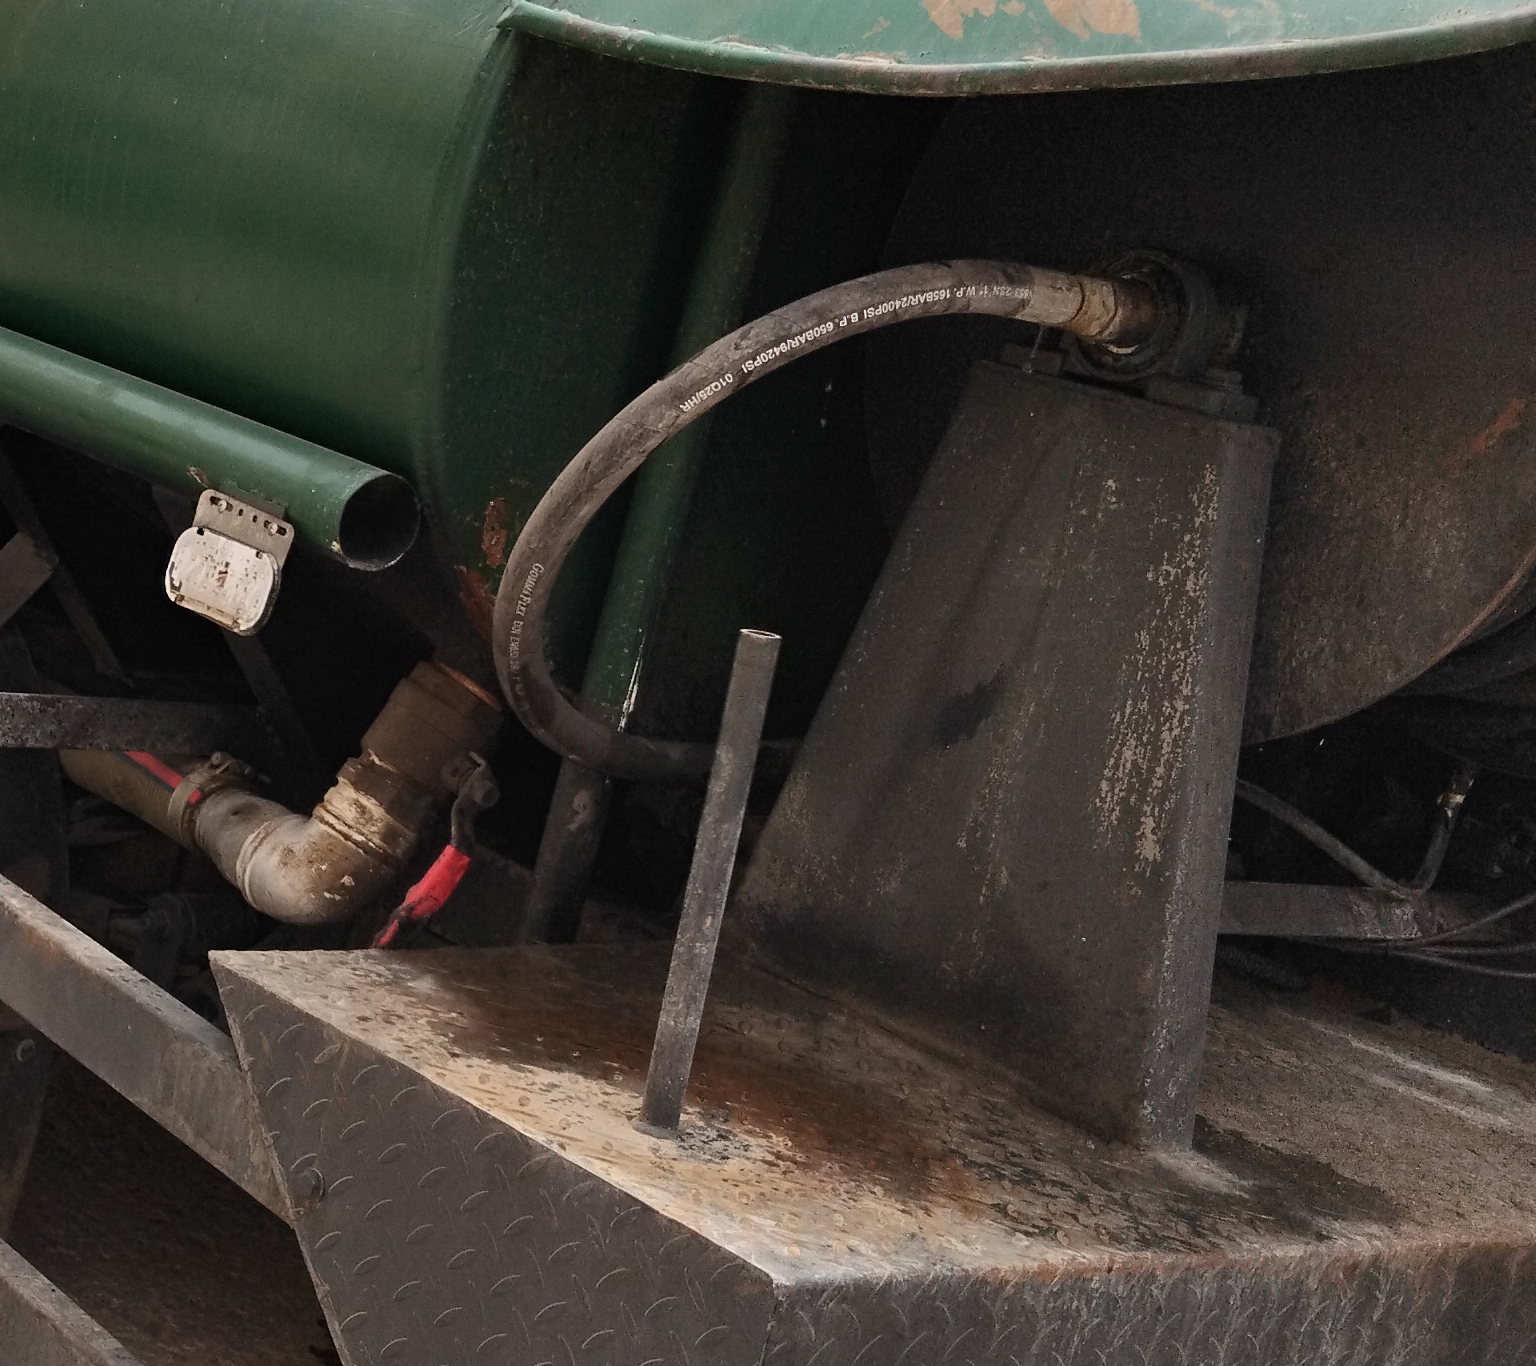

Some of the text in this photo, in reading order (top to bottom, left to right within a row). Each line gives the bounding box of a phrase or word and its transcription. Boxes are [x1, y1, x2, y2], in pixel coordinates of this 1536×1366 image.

[834, 311, 859, 327] B.P.
[863, 287, 951, 319] 165BAR/2400PSI
[741, 321, 834, 373] 650BAR/9420PSI
